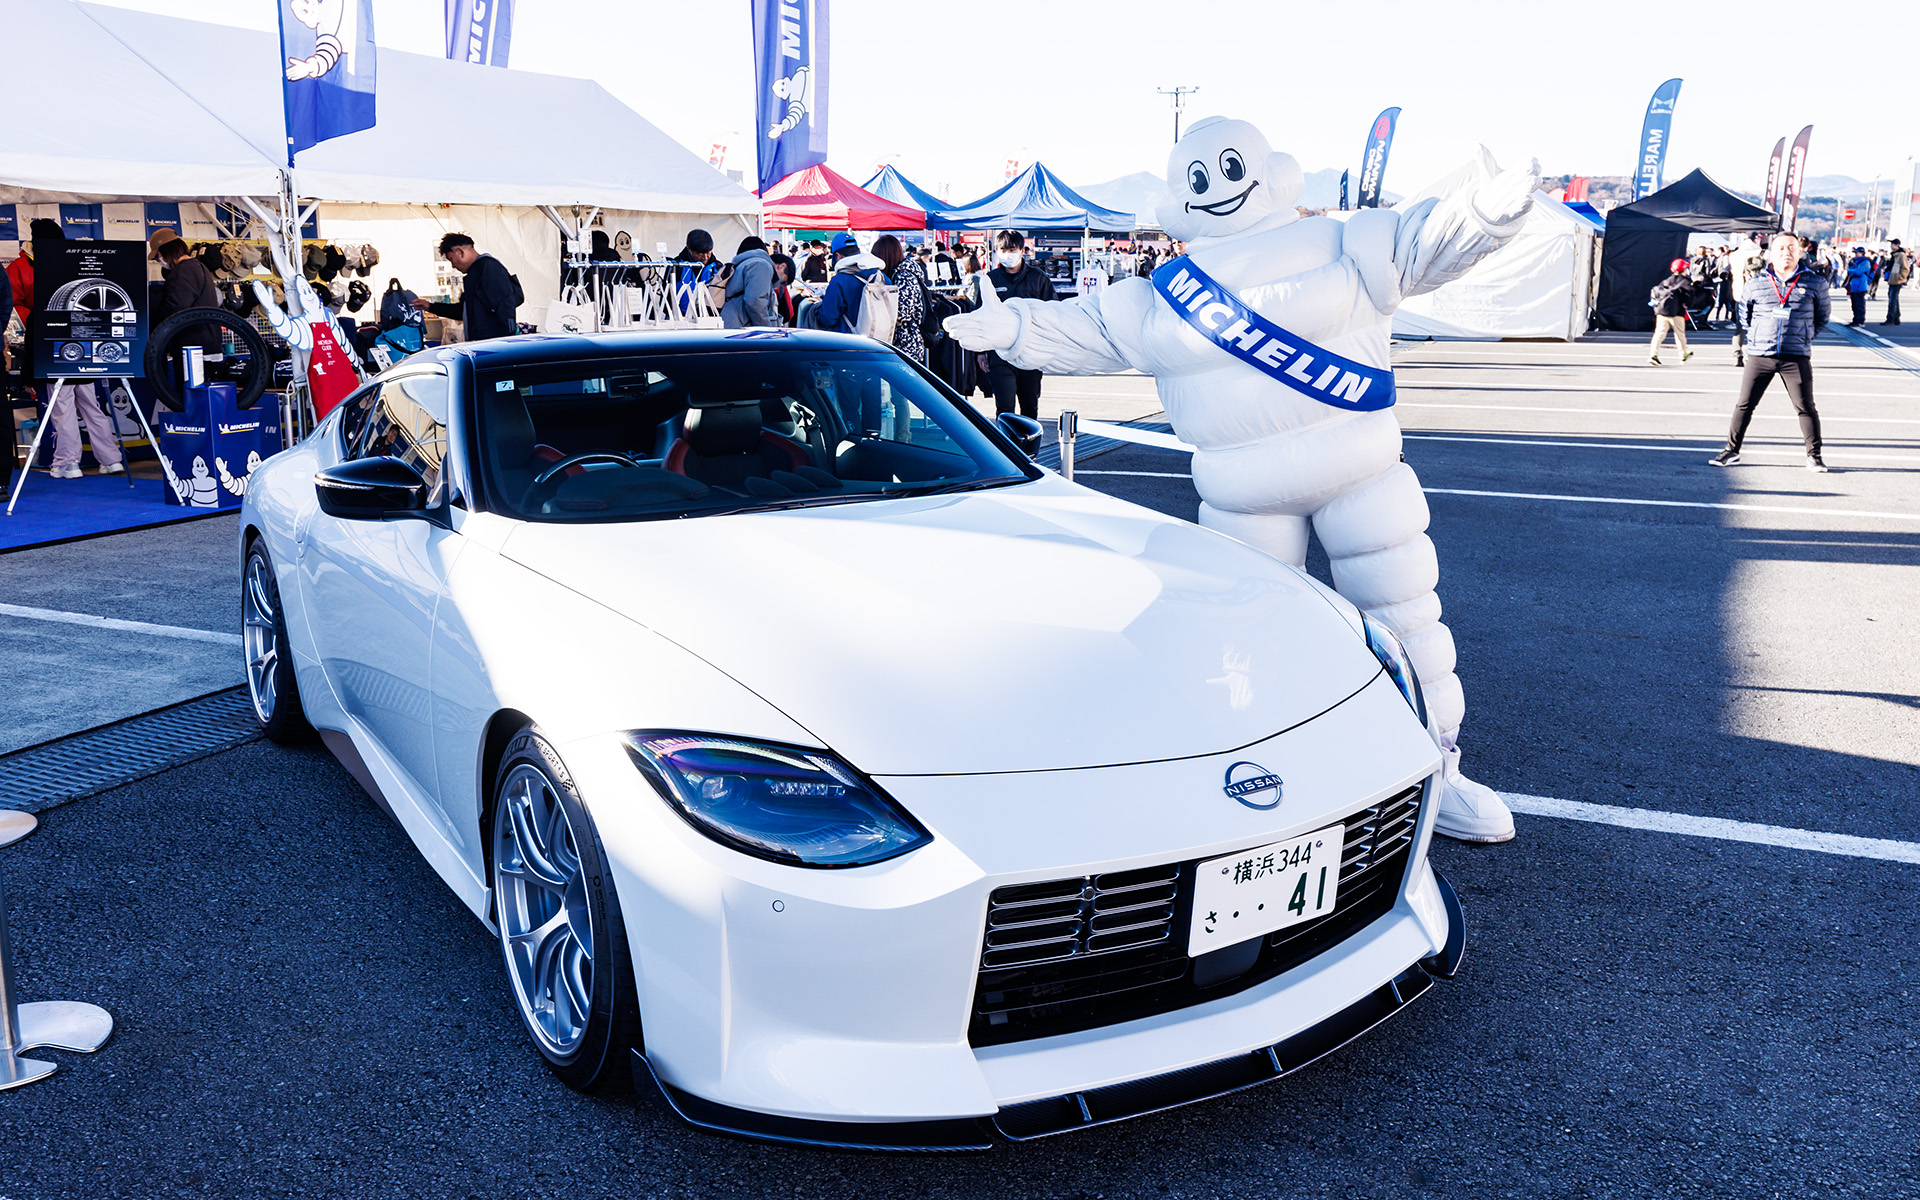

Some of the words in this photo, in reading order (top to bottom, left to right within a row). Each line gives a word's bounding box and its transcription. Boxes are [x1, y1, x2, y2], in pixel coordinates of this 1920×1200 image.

[781, 0, 801, 61] MI
[1166, 267, 1373, 405] MICHELIN
[229, 422, 260, 431] MICHELIN
[542, 747, 559, 768] SPORT
[1226, 775, 1283, 797] NISSAN
[1205, 910, 1218, 934] さ
